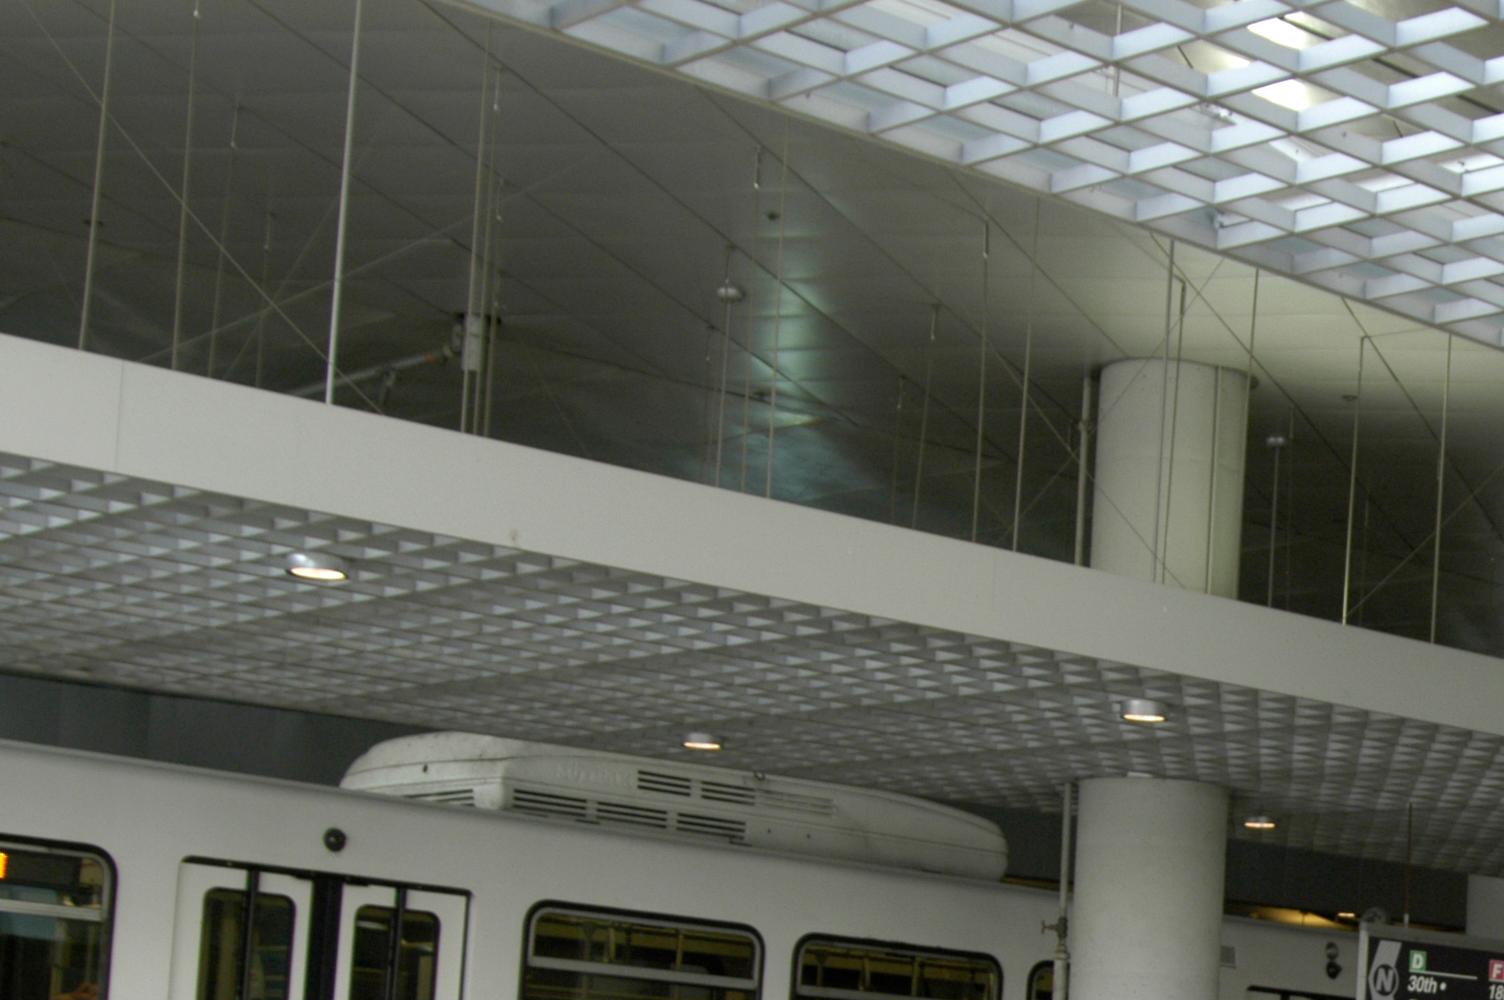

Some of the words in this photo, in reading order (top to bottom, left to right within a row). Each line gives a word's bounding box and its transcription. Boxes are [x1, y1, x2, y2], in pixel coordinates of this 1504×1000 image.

[1412, 954, 1424, 969] D
[1376, 966, 1395, 993] N
[1407, 975, 1438, 993] 30th
